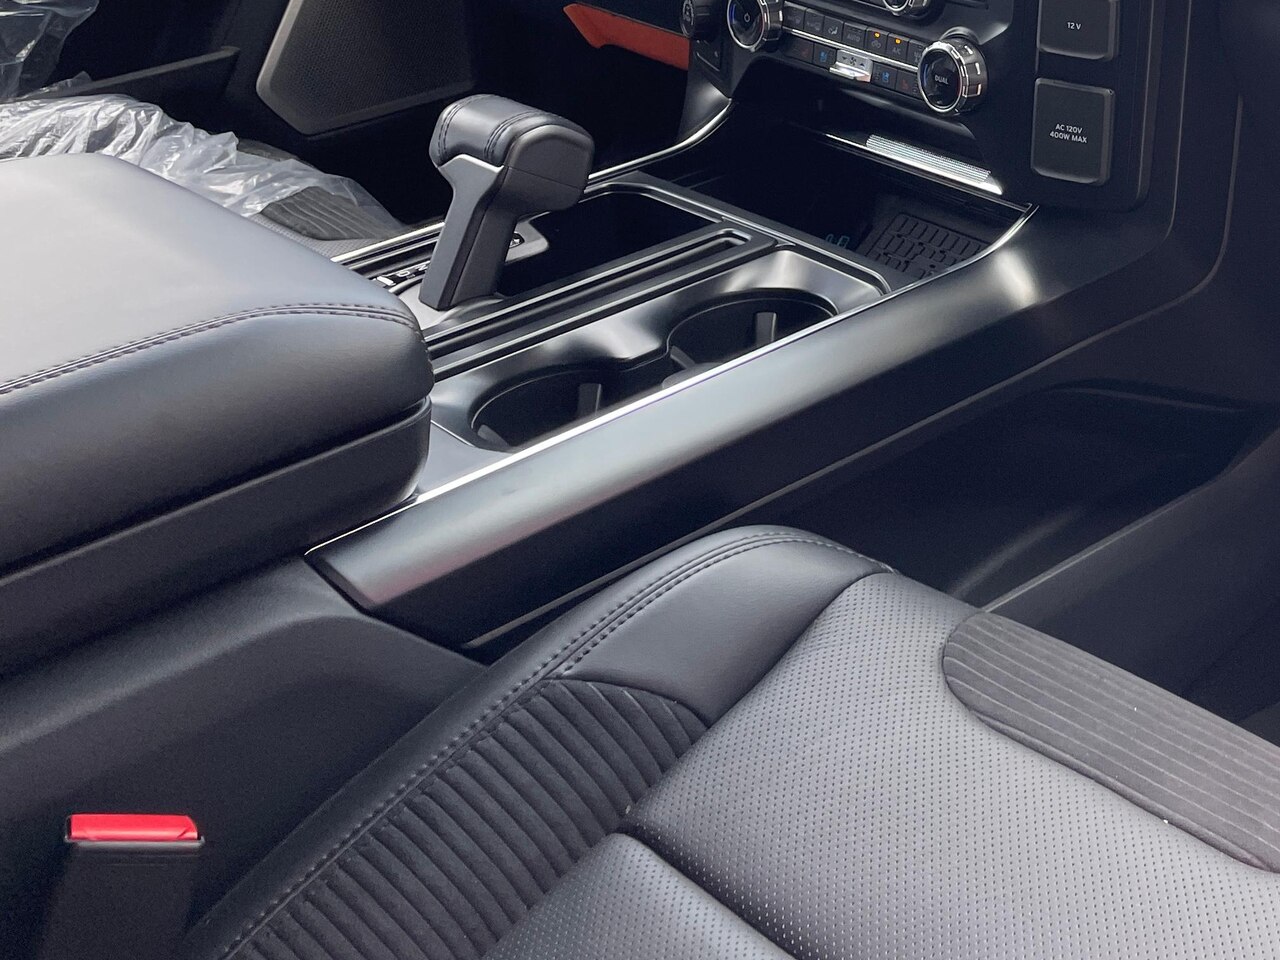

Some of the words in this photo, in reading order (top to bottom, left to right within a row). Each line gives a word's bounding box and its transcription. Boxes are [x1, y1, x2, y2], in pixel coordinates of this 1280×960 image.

[934, 74, 949, 86] DUAL
[1055, 123, 1065, 131] AC
[1066, 125, 1083, 134] 120V
[1049, 131, 1070, 141] 400W
[1071, 134, 1088, 144] MAX
